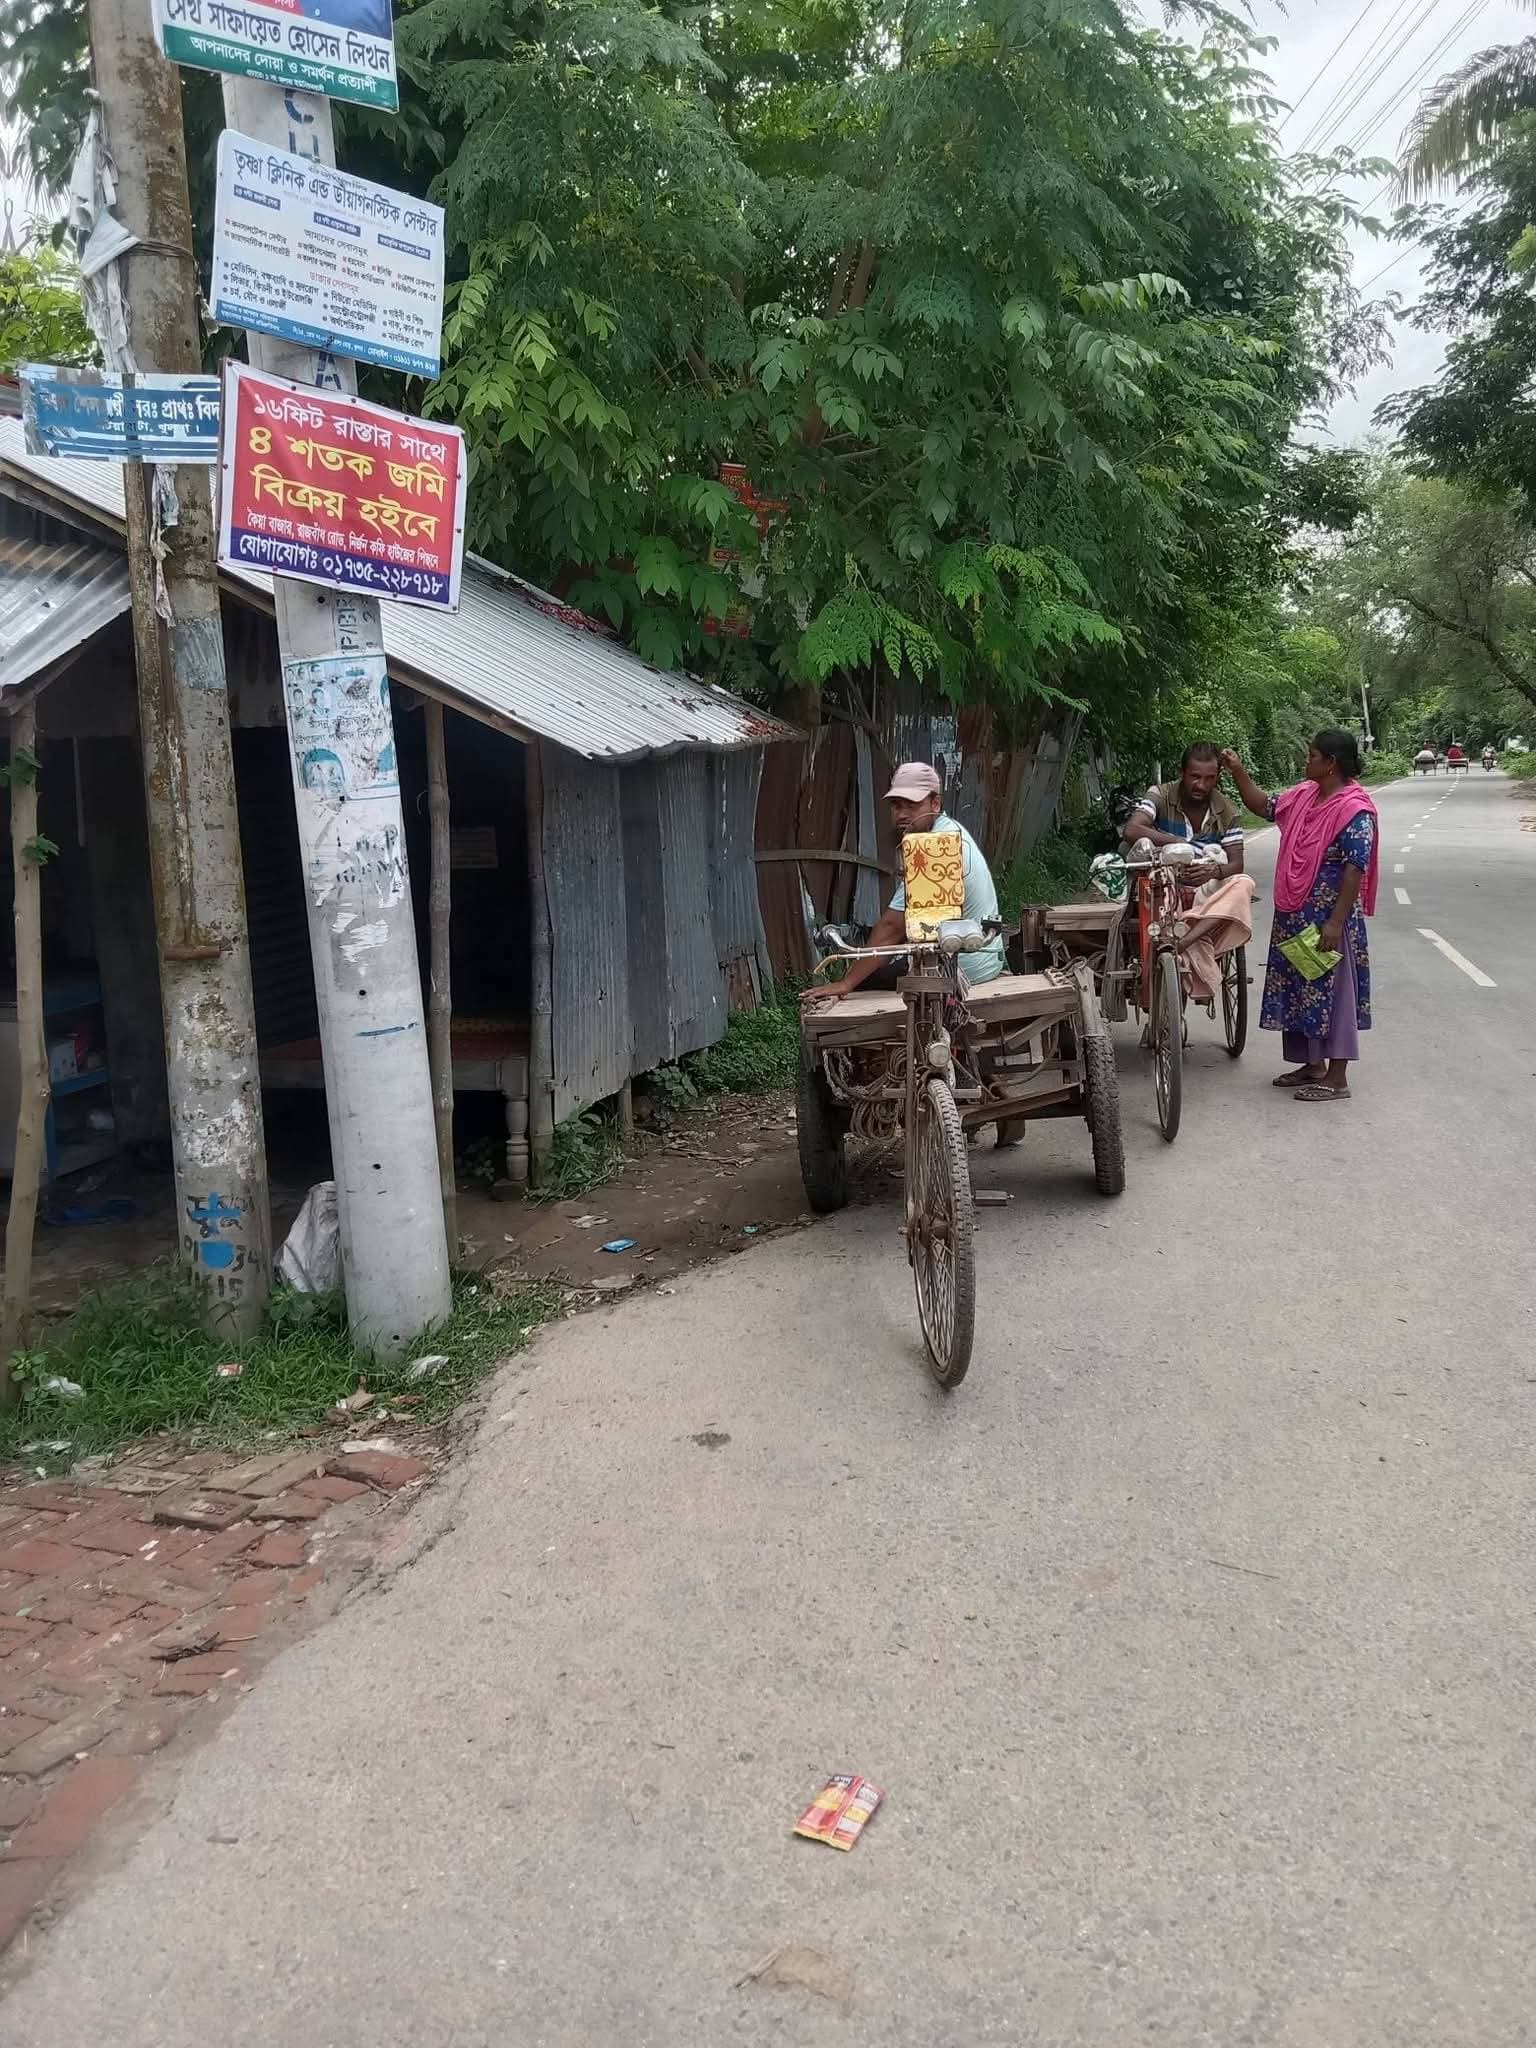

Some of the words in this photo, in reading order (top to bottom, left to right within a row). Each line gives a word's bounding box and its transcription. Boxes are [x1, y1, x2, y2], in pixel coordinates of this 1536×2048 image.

[190, 38, 251, 63] আপনাদের
[254, 53, 284, 72] দোয়া
[287, 62, 298, 73] ও
[301, 66, 335, 82] সমর্থন
[337, 74, 377, 93] প্রত্যাশী
[208, 3, 281, 44] সাফায়েত
[288, 25, 340, 60] হোসেন
[346, 31, 390, 73] লিখন
[234, 150, 262, 179] তৃষ্ণা
[268, 160, 305, 194] ক্লিনিক
[309, 176, 330, 201] এন্ড
[404, 208, 438, 239] সেন্টার
[304, 229, 335, 247] আমাদের
[254, 391, 326, 432] ১৬ফিট
[332, 415, 393, 450] রাস্তার
[398, 434, 446, 465] সাথে
[249, 425, 272, 457] ৪
[285, 435, 376, 484] শতক
[384, 459, 448, 503] জমি
[248, 509, 266, 530] কৈয়া
[269, 517, 295, 538] বাজার,
[297, 523, 325, 544] রাজবাঁধ
[328, 531, 346, 549] রোড,
[349, 534, 368, 552] নির্জন
[370, 539, 385, 557] কফি
[388, 544, 416, 563] হাউজের
[417, 551, 439, 569] পিছনে
[250, 465, 347, 520] বিক্রয়
[355, 496, 440, 545] হইবে
[240, 535, 317, 570] যোগাযোগঃ
[323, 554, 443, 597] ০১৭৩৫-২২৮৭১৮
